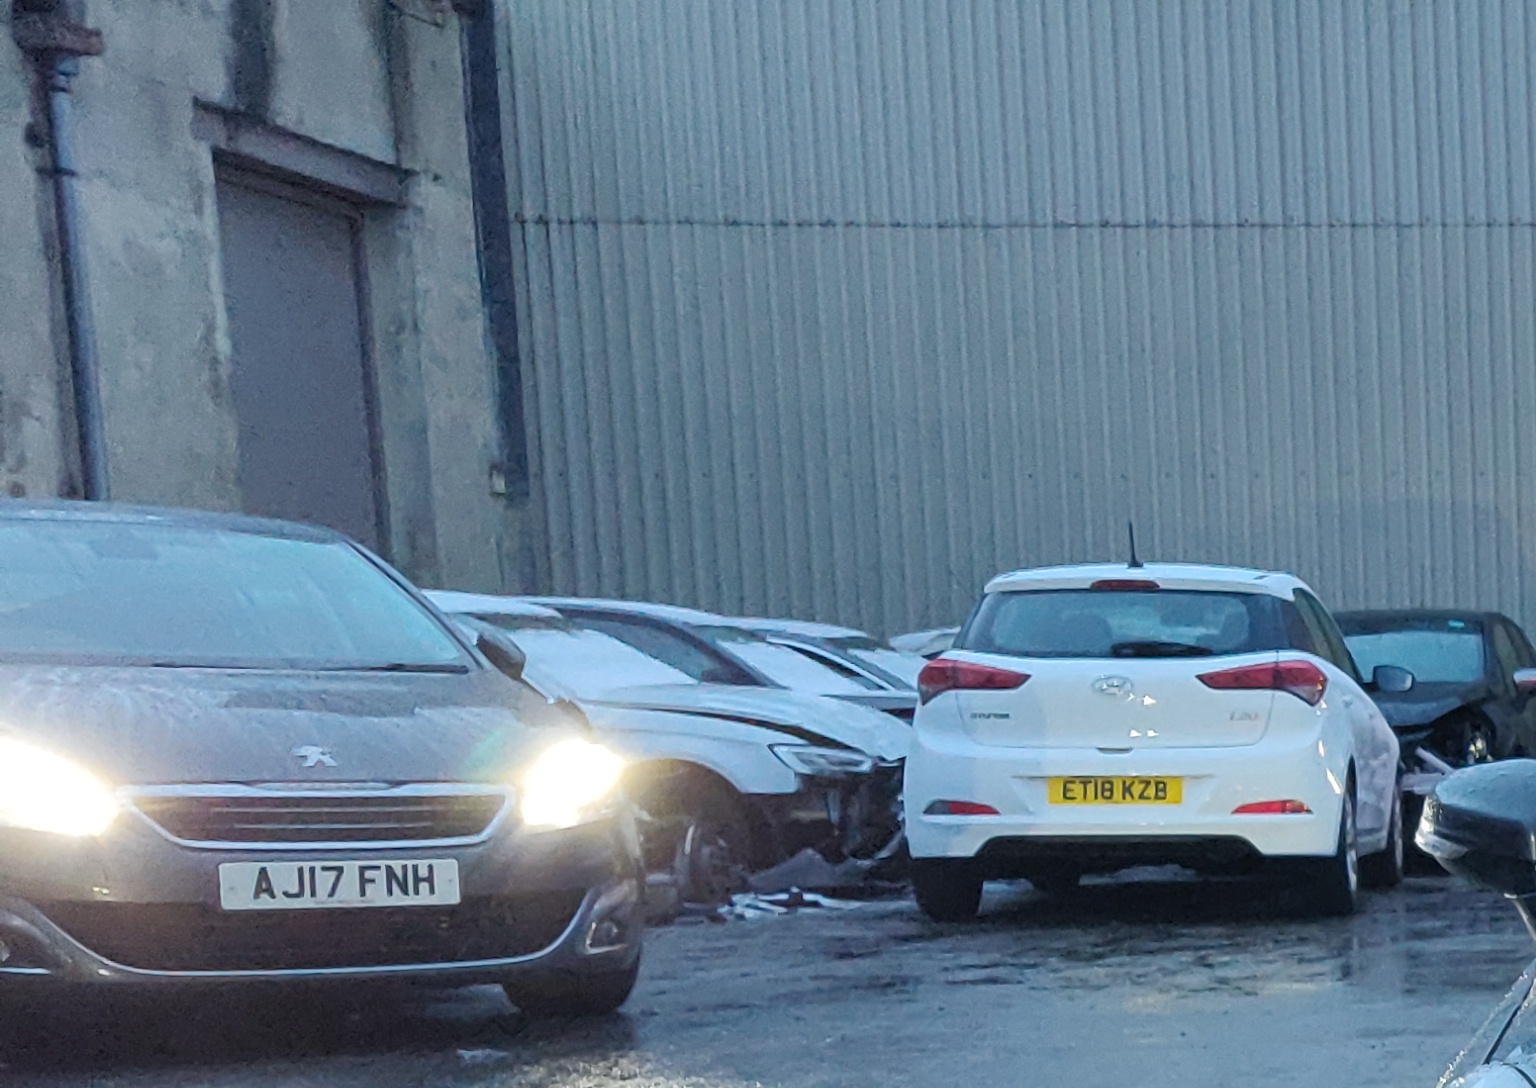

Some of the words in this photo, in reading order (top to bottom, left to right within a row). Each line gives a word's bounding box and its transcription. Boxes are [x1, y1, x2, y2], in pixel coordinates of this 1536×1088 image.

[1062, 779, 1115, 801] ET18
[1121, 779, 1168, 801] KZB
[252, 865, 345, 900] AJ17
[358, 863, 437, 898] FNH
